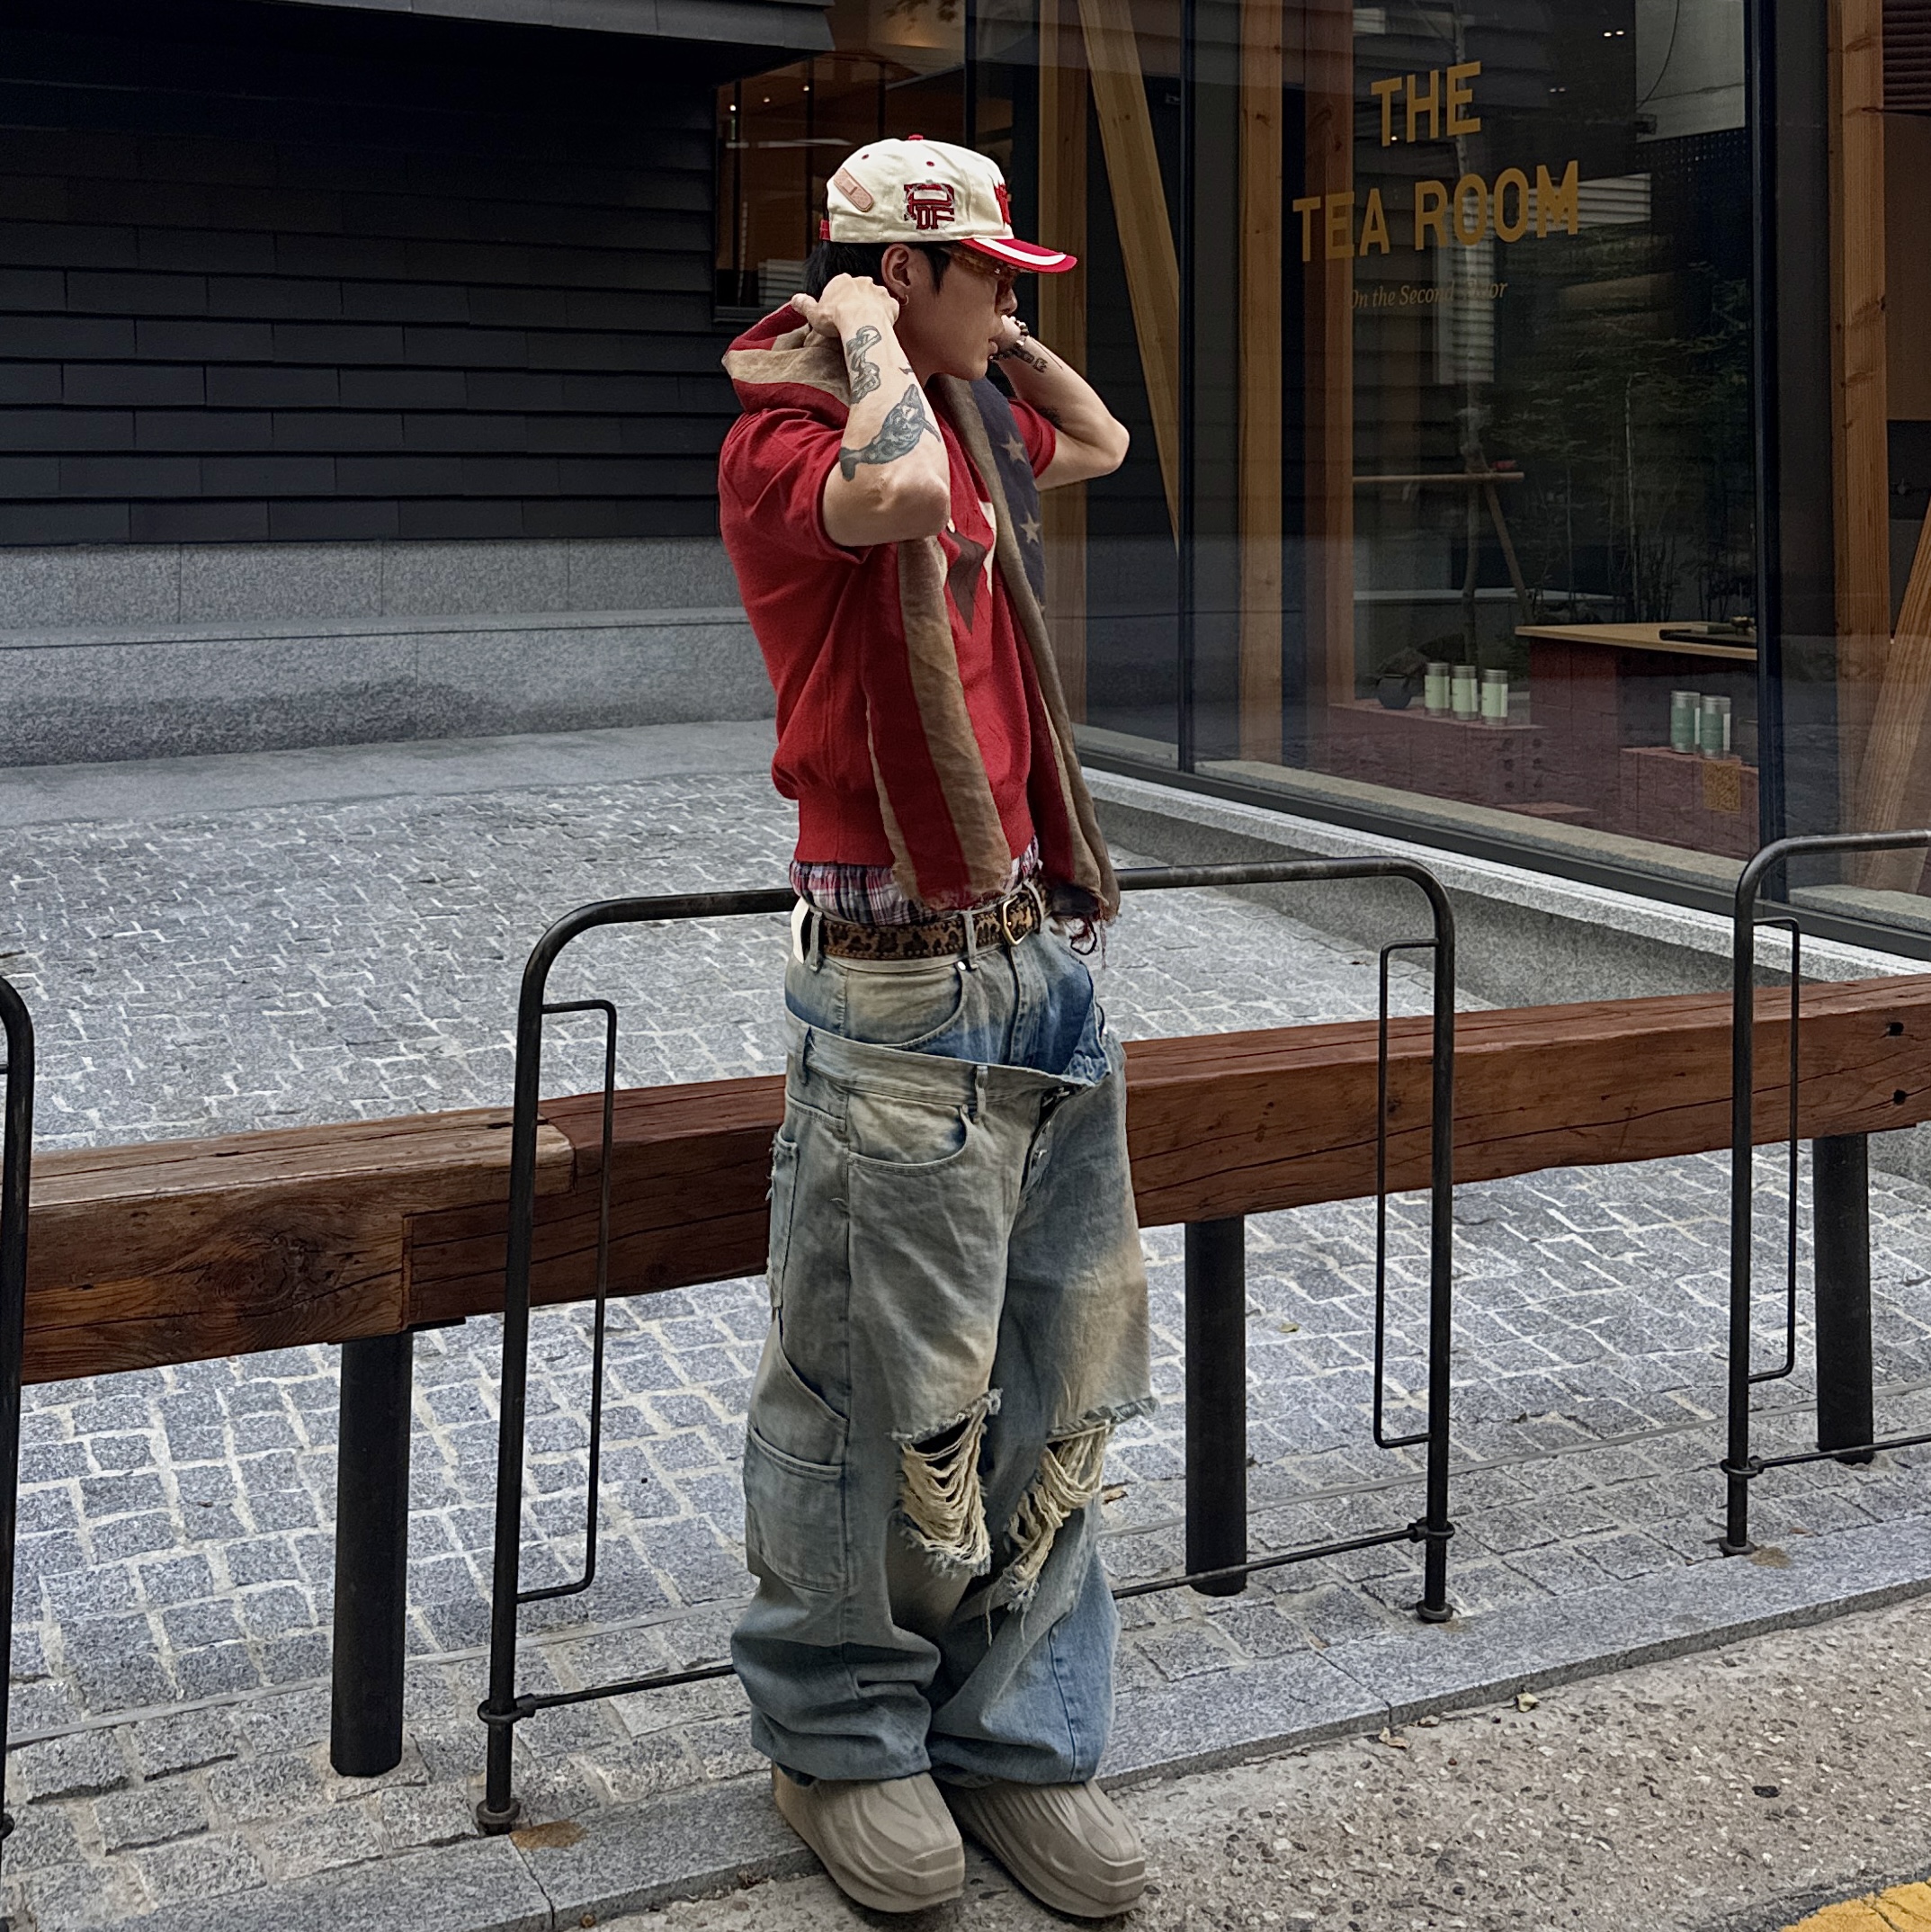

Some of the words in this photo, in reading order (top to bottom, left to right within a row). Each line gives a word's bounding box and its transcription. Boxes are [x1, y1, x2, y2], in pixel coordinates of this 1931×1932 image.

[1371, 60, 1481, 147] THE
[1292, 187, 1390, 262] TEA
[1415, 159, 1579, 251] ROOM
[1372, 285, 1396, 308] the
[1399, 279, 1454, 306] Second
